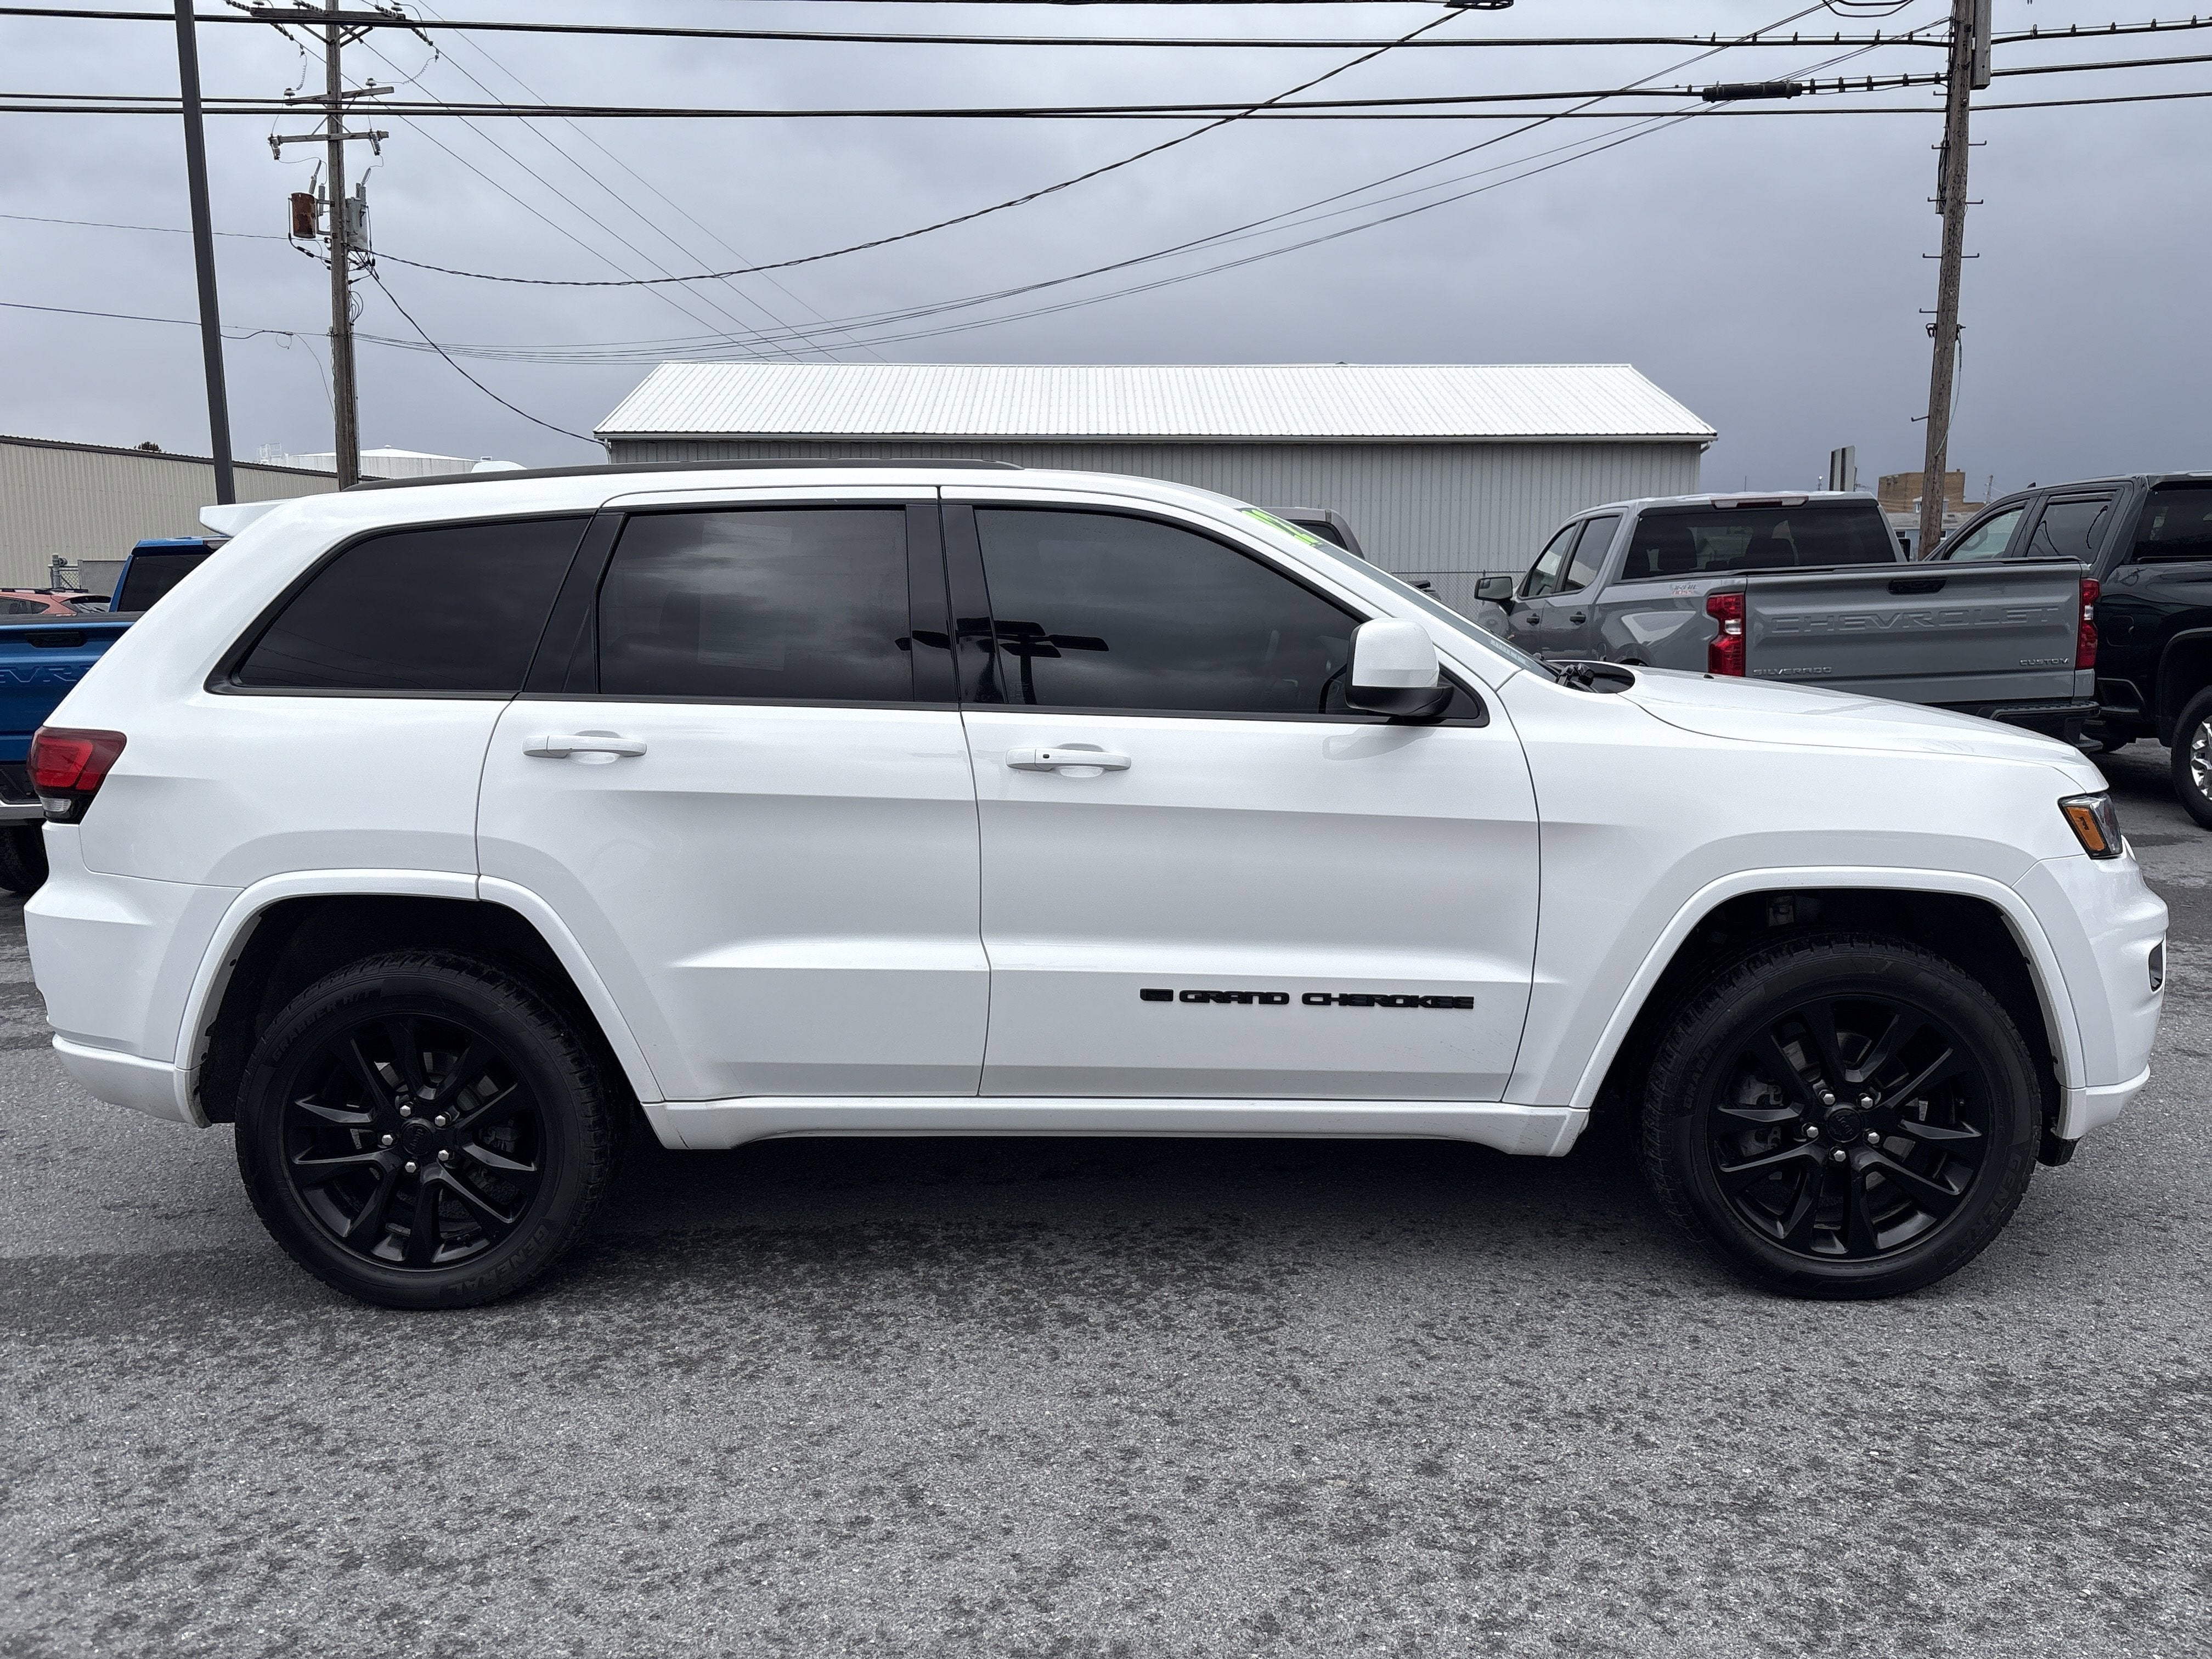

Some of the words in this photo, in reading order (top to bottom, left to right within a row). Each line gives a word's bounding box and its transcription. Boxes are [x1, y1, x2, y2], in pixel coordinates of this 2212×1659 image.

[1771, 606, 2061, 633] CHEVROLET
[1753, 666, 1832, 676] SILVERADO
[2019, 658, 2069, 666] CUSTOM
[1180, 990, 1290, 1005] GRAND
[1302, 992, 1475, 1009] CHEROKEE
[445, 1223, 550, 1296] GENERAL
